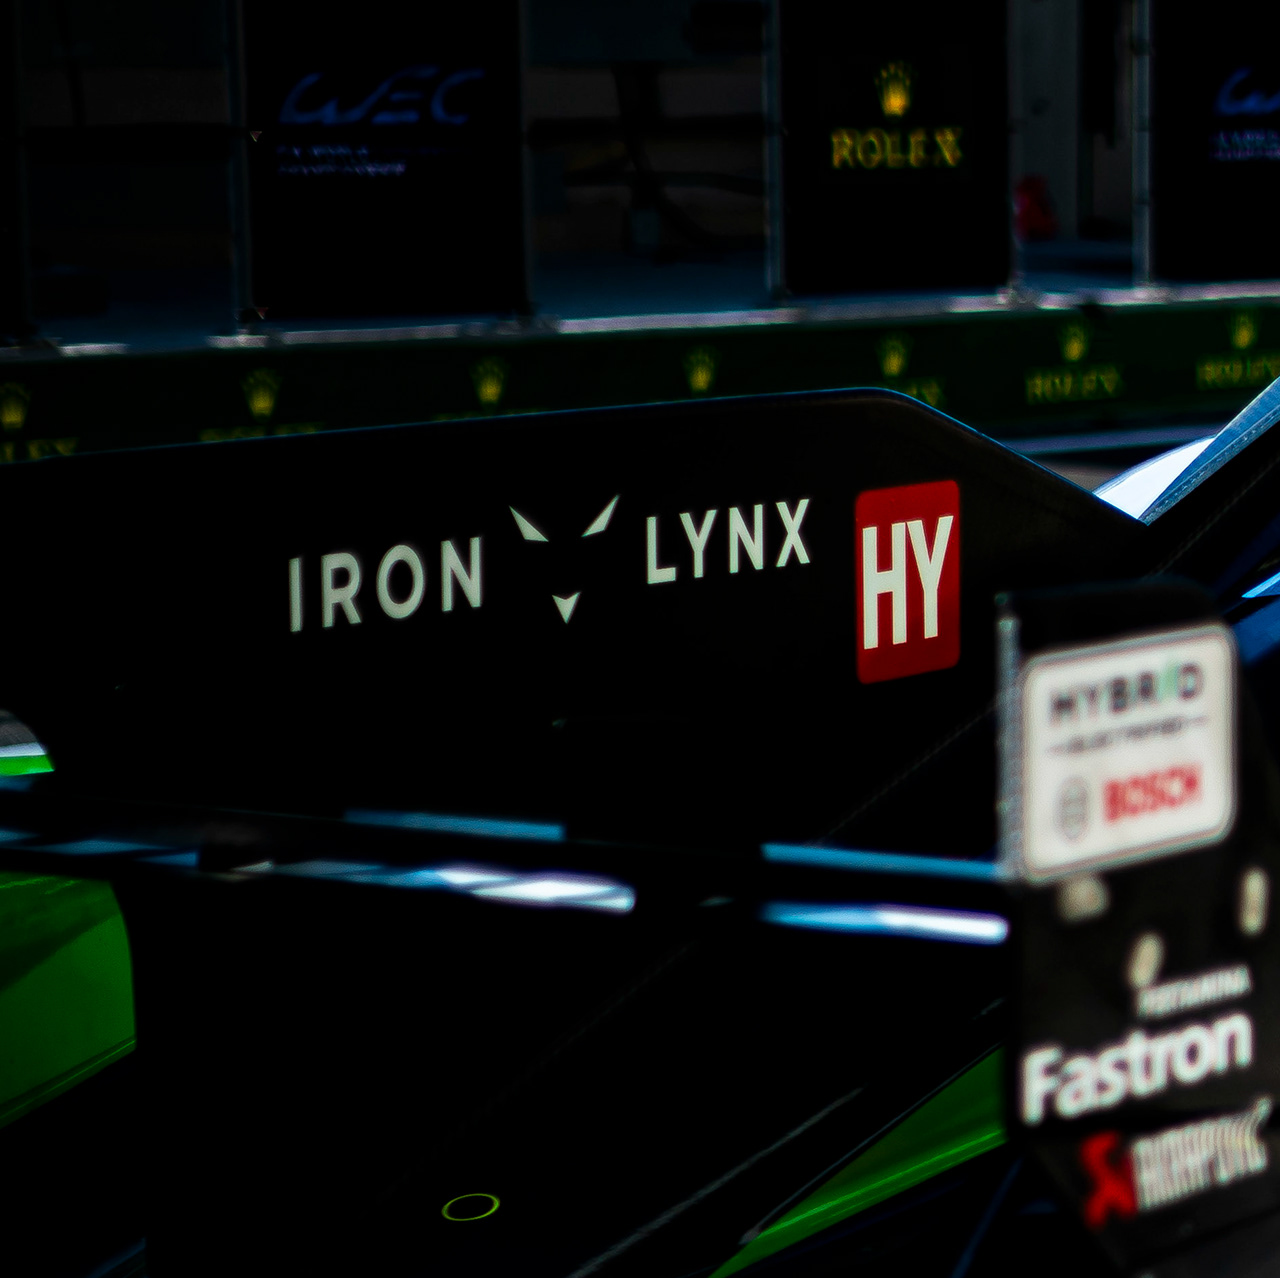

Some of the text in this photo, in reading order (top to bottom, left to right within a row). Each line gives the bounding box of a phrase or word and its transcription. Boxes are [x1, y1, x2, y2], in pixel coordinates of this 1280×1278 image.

[278, 64, 485, 125] WEC
[829, 126, 963, 170] ROLEX
[289, 499, 810, 632] IRON LYNX
[862, 516, 953, 649] HY
[1104, 765, 1203, 826] BOSCH
[1021, 1013, 1253, 1126] Fastron
